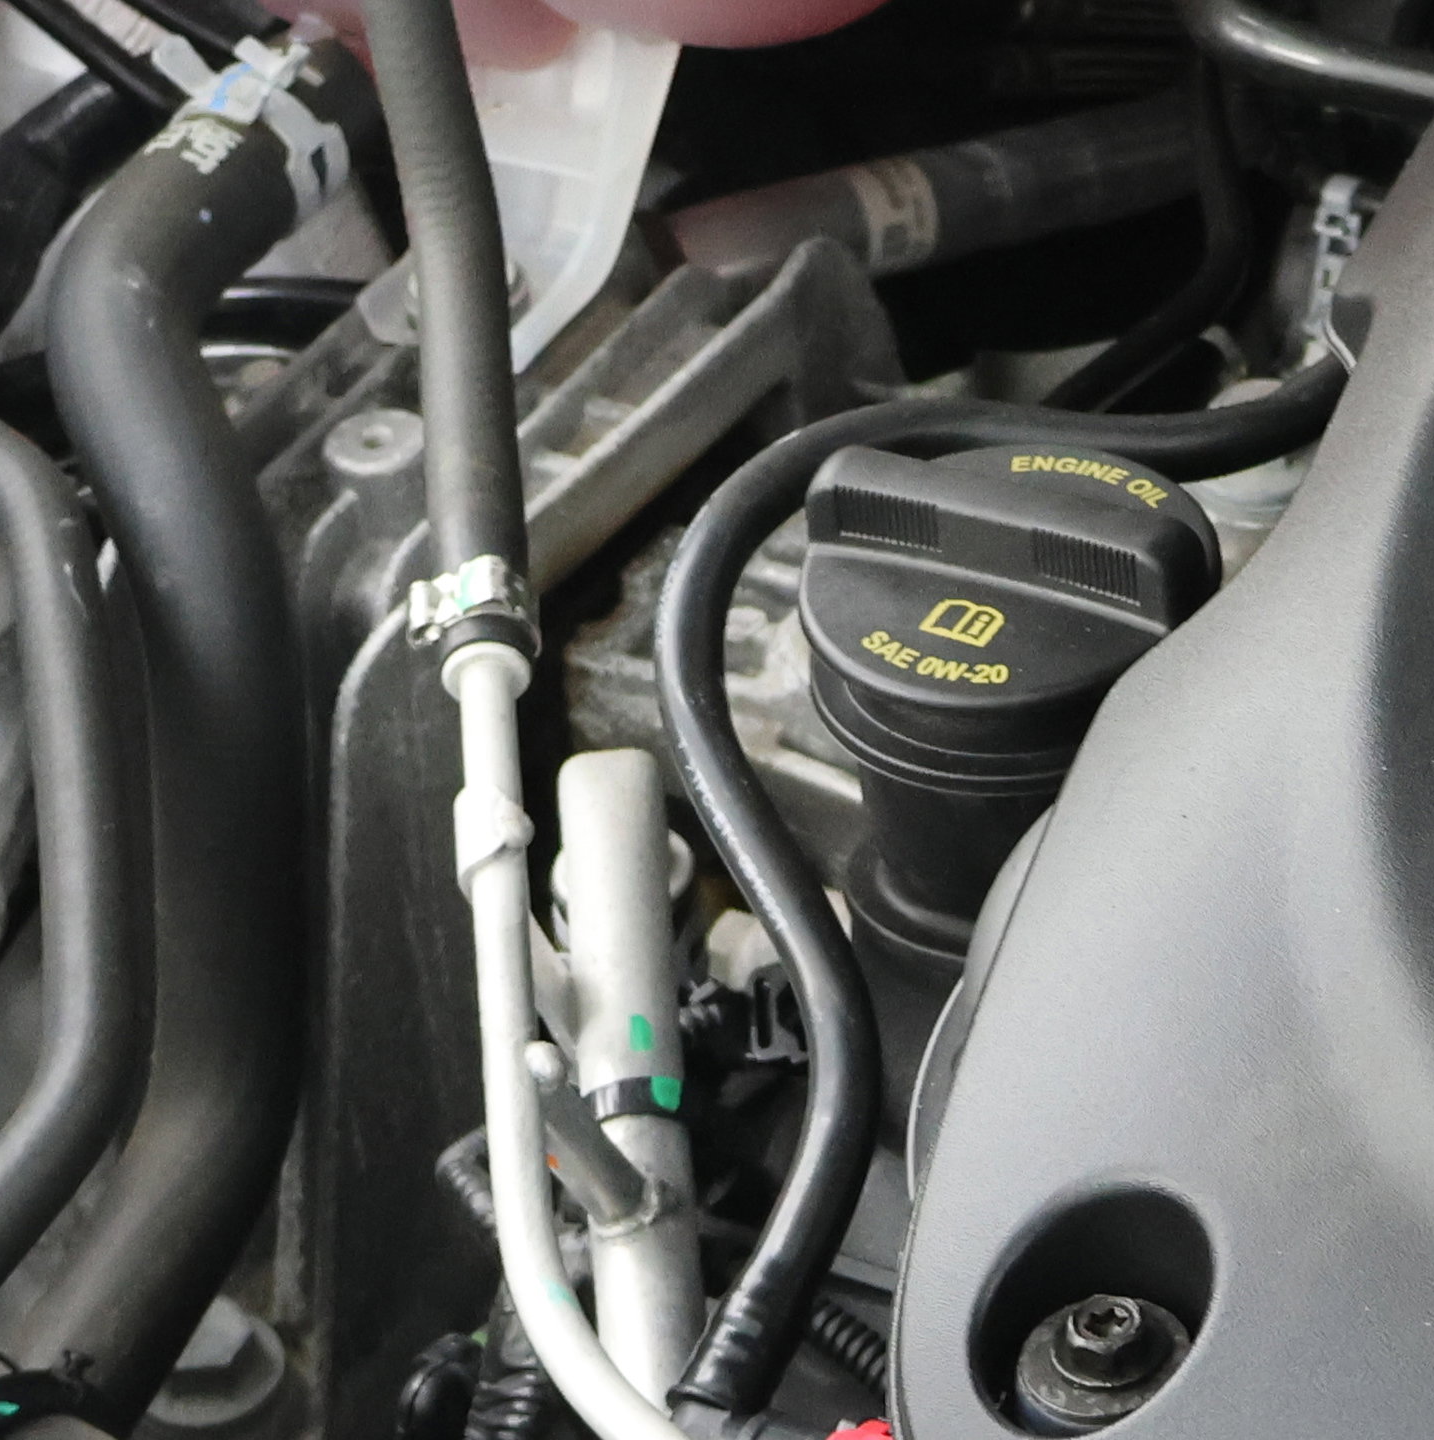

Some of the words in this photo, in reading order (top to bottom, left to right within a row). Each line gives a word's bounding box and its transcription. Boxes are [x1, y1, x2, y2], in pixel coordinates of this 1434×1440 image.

[1010, 455, 1132, 486] ENGINE
[1125, 477, 1170, 509] OIL
[861, 630, 922, 669] SAE
[916, 655, 1009, 685] 0W-20
